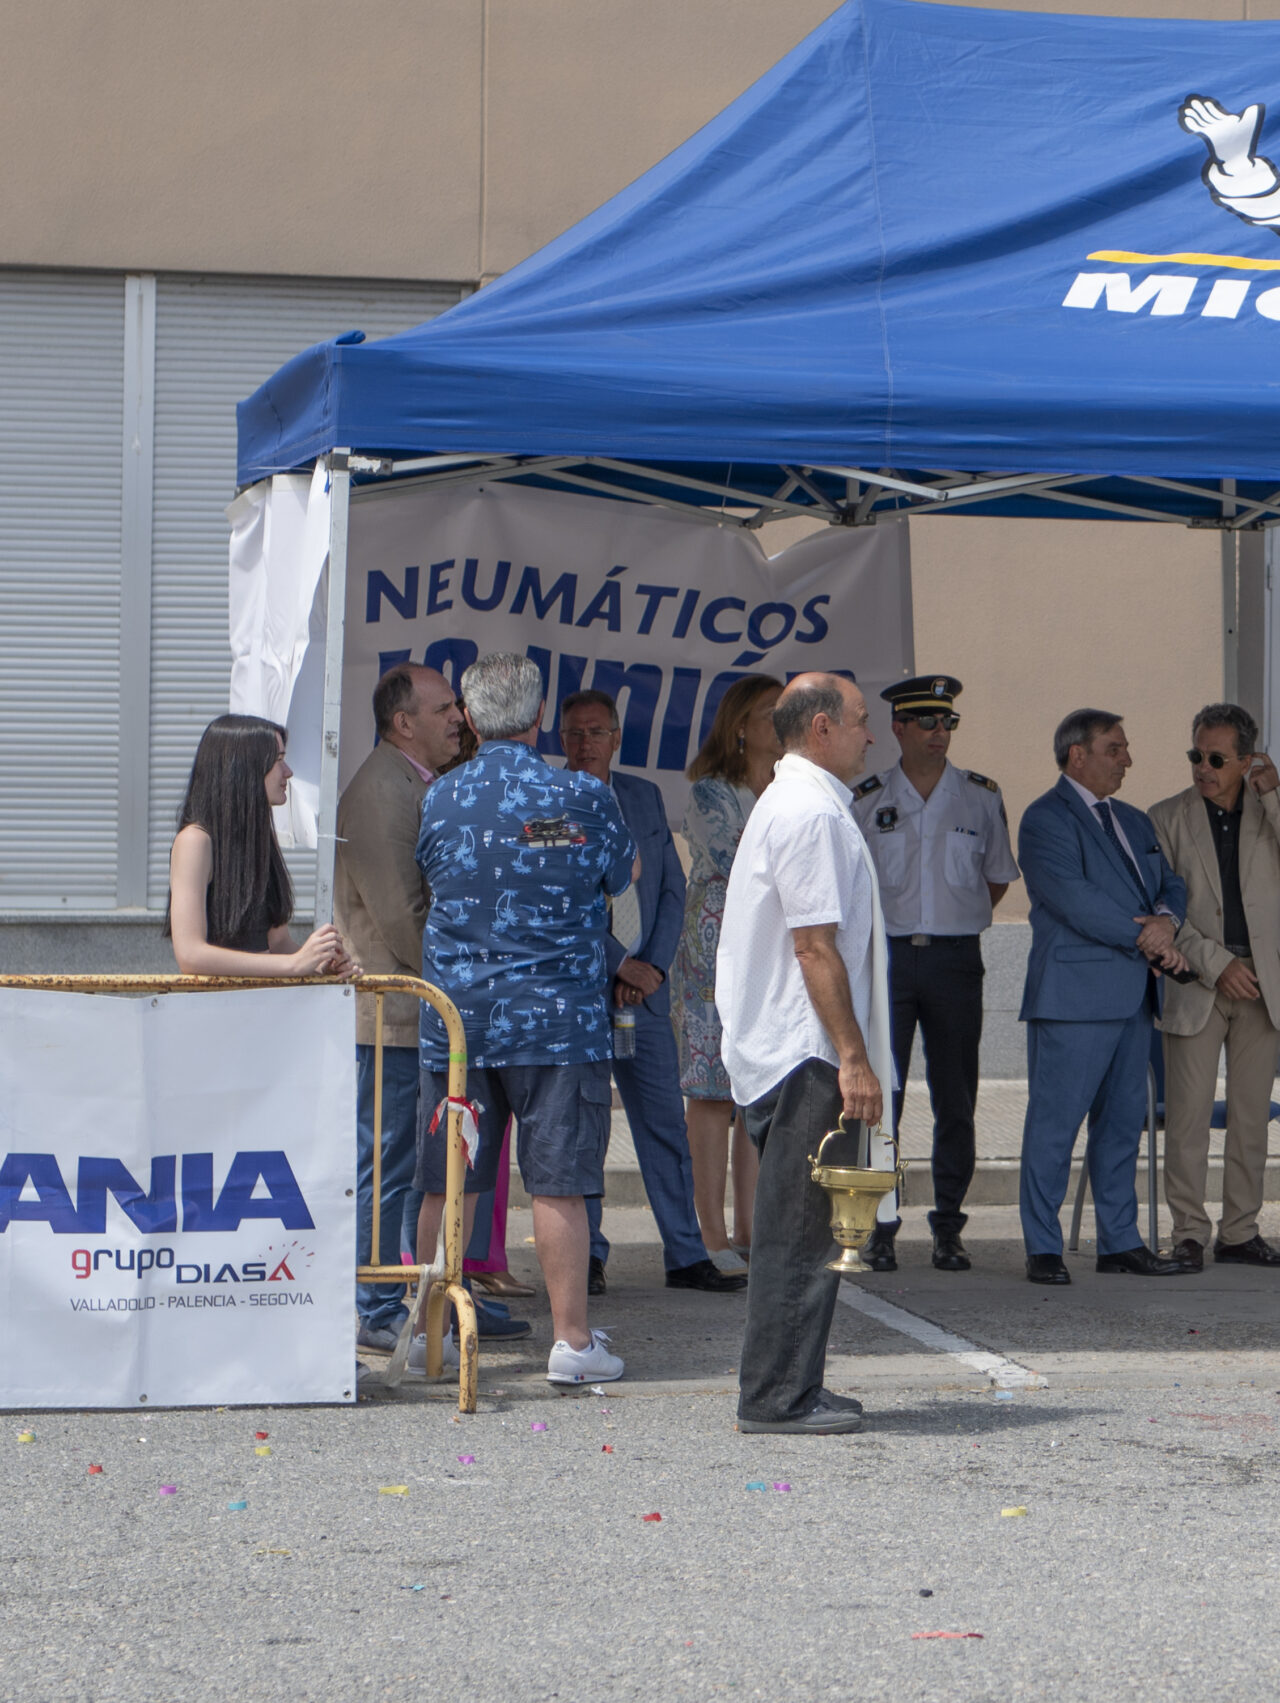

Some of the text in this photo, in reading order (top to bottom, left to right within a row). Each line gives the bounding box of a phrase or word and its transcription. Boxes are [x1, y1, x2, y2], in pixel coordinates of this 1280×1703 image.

[365, 557, 832, 649] NEUMÁTICOS
[0, 1150, 316, 1234] ANIA
[71, 1247, 296, 1284] grupo DIASA
[167, 1294, 237, 1309] PALENCIA
[248, 1292, 314, 1307] SEGOVIA
